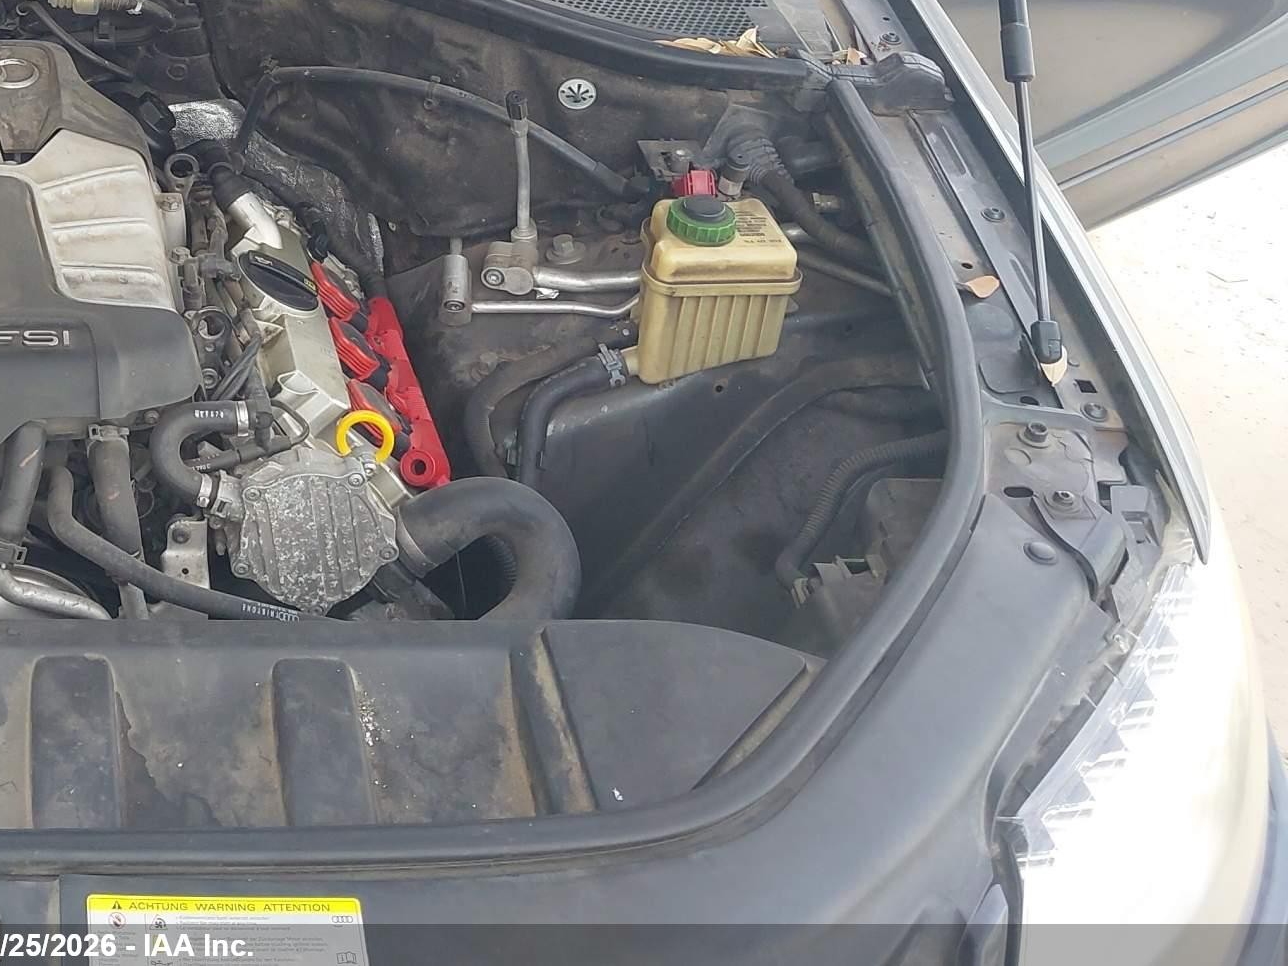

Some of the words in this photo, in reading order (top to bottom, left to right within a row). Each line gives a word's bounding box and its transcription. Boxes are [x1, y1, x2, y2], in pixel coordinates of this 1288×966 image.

[128, 902, 189, 911] ACHTUNG
[195, 903, 256, 912] WARNING
[263, 903, 331, 912] ATTENTION
